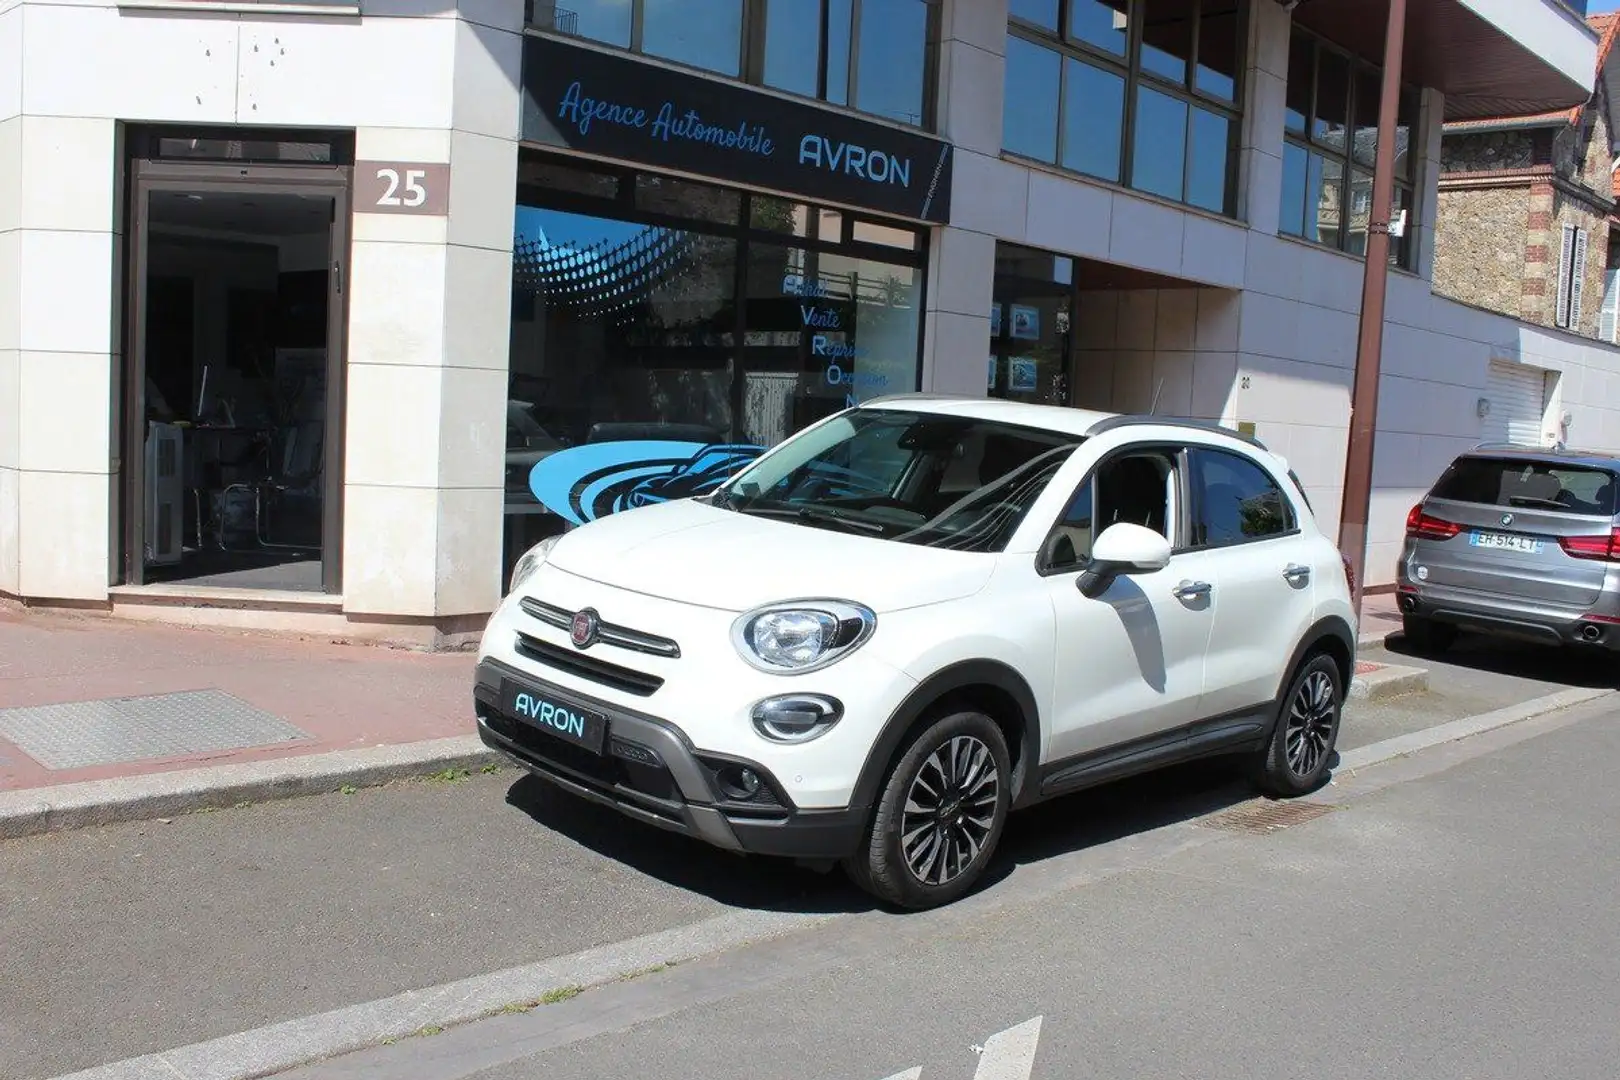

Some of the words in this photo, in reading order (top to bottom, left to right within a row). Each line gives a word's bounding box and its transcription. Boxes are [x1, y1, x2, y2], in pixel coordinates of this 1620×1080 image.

[558, 81, 648, 134] Agence
[651, 102, 776, 156] Automobile
[799, 134, 910, 188] AVRON
[375, 168, 426, 207] 25
[801, 305, 840, 328] Vente
[515, 693, 585, 738] AVRON
